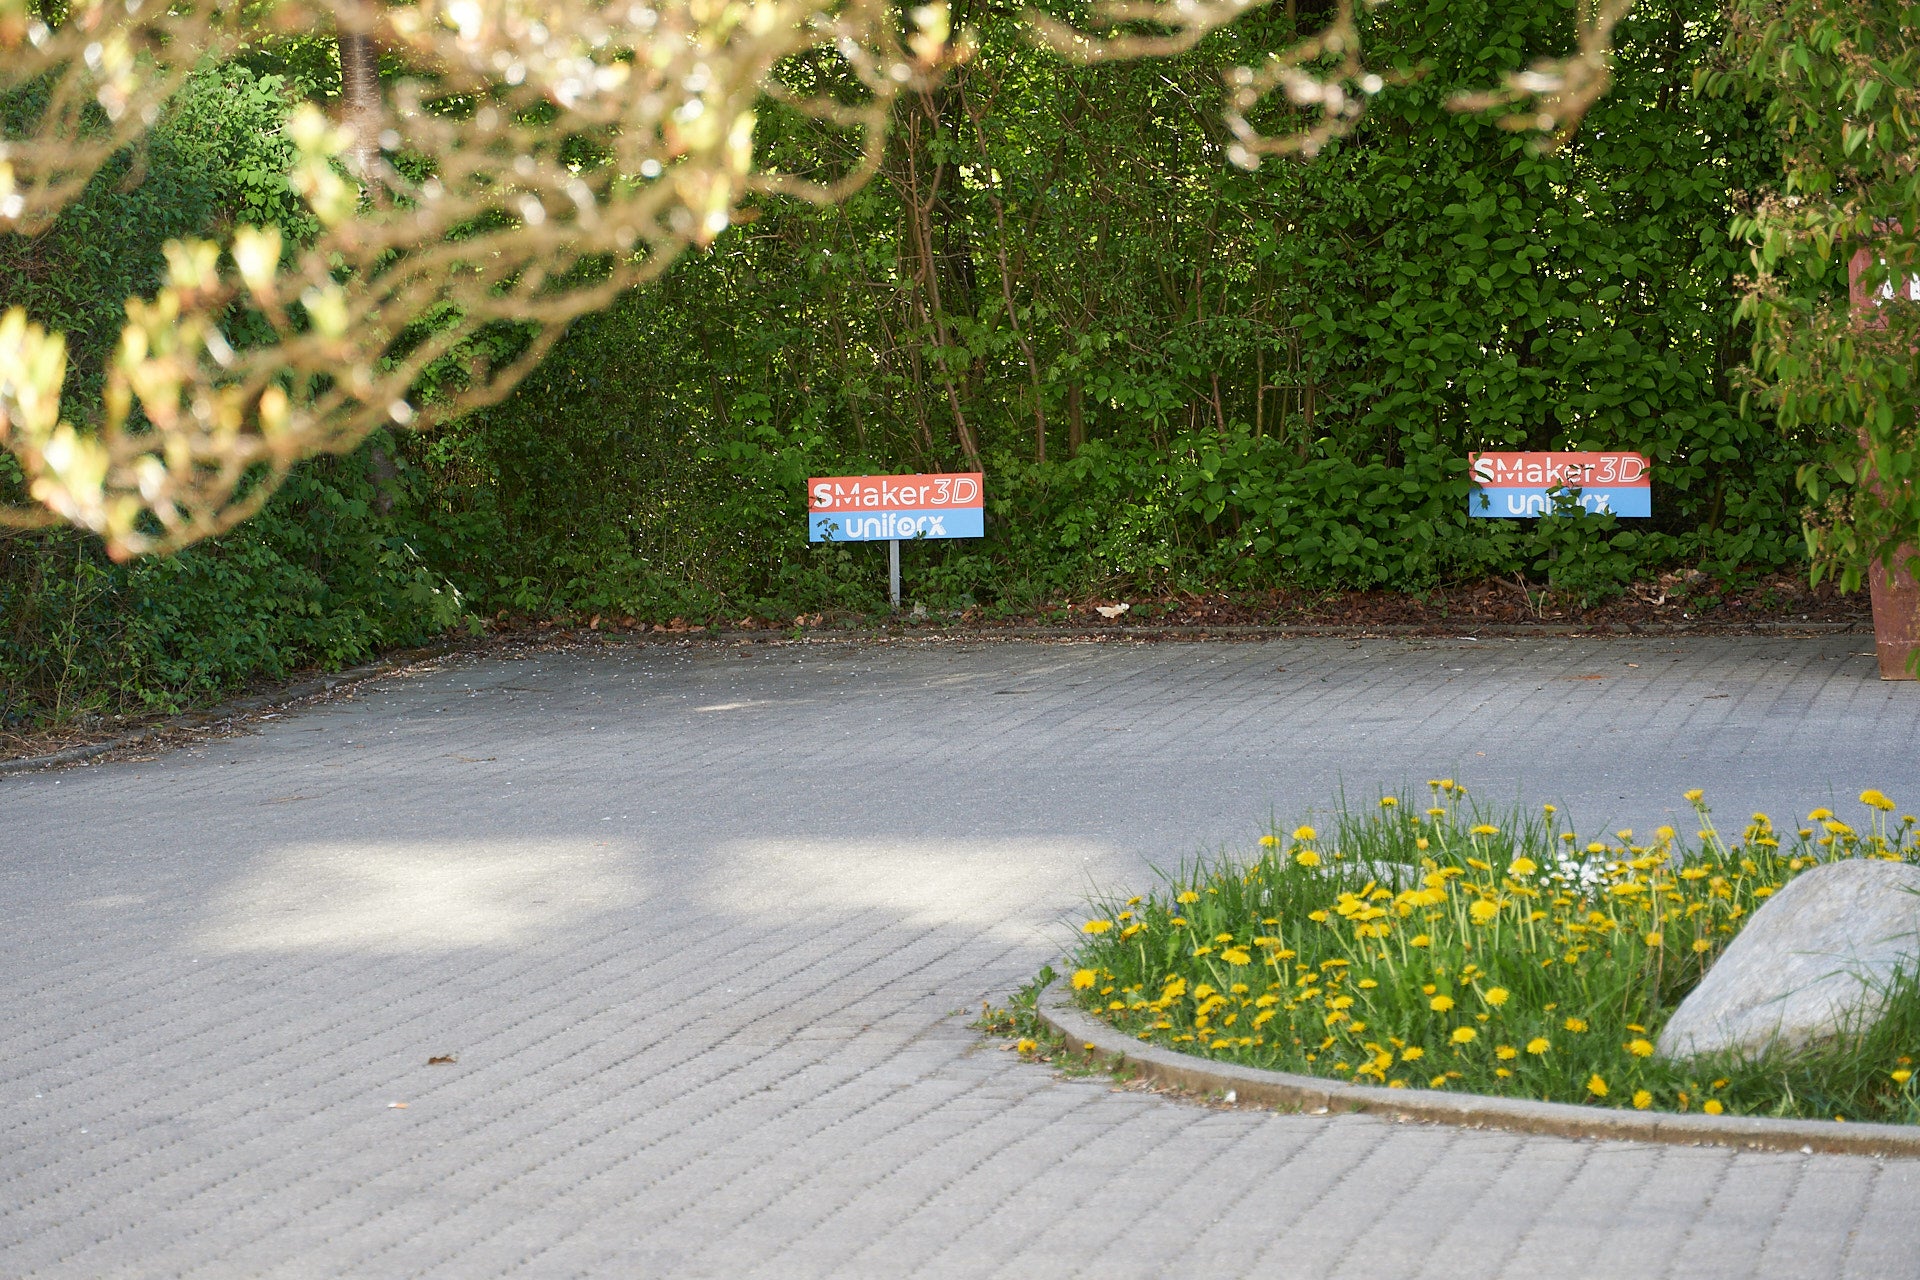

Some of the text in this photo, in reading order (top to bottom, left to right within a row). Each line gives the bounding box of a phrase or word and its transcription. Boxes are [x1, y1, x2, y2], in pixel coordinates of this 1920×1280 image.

[813, 478, 978, 508] SMaker3D
[1507, 491, 1613, 515] unirx
[845, 513, 947, 538] uniforx
